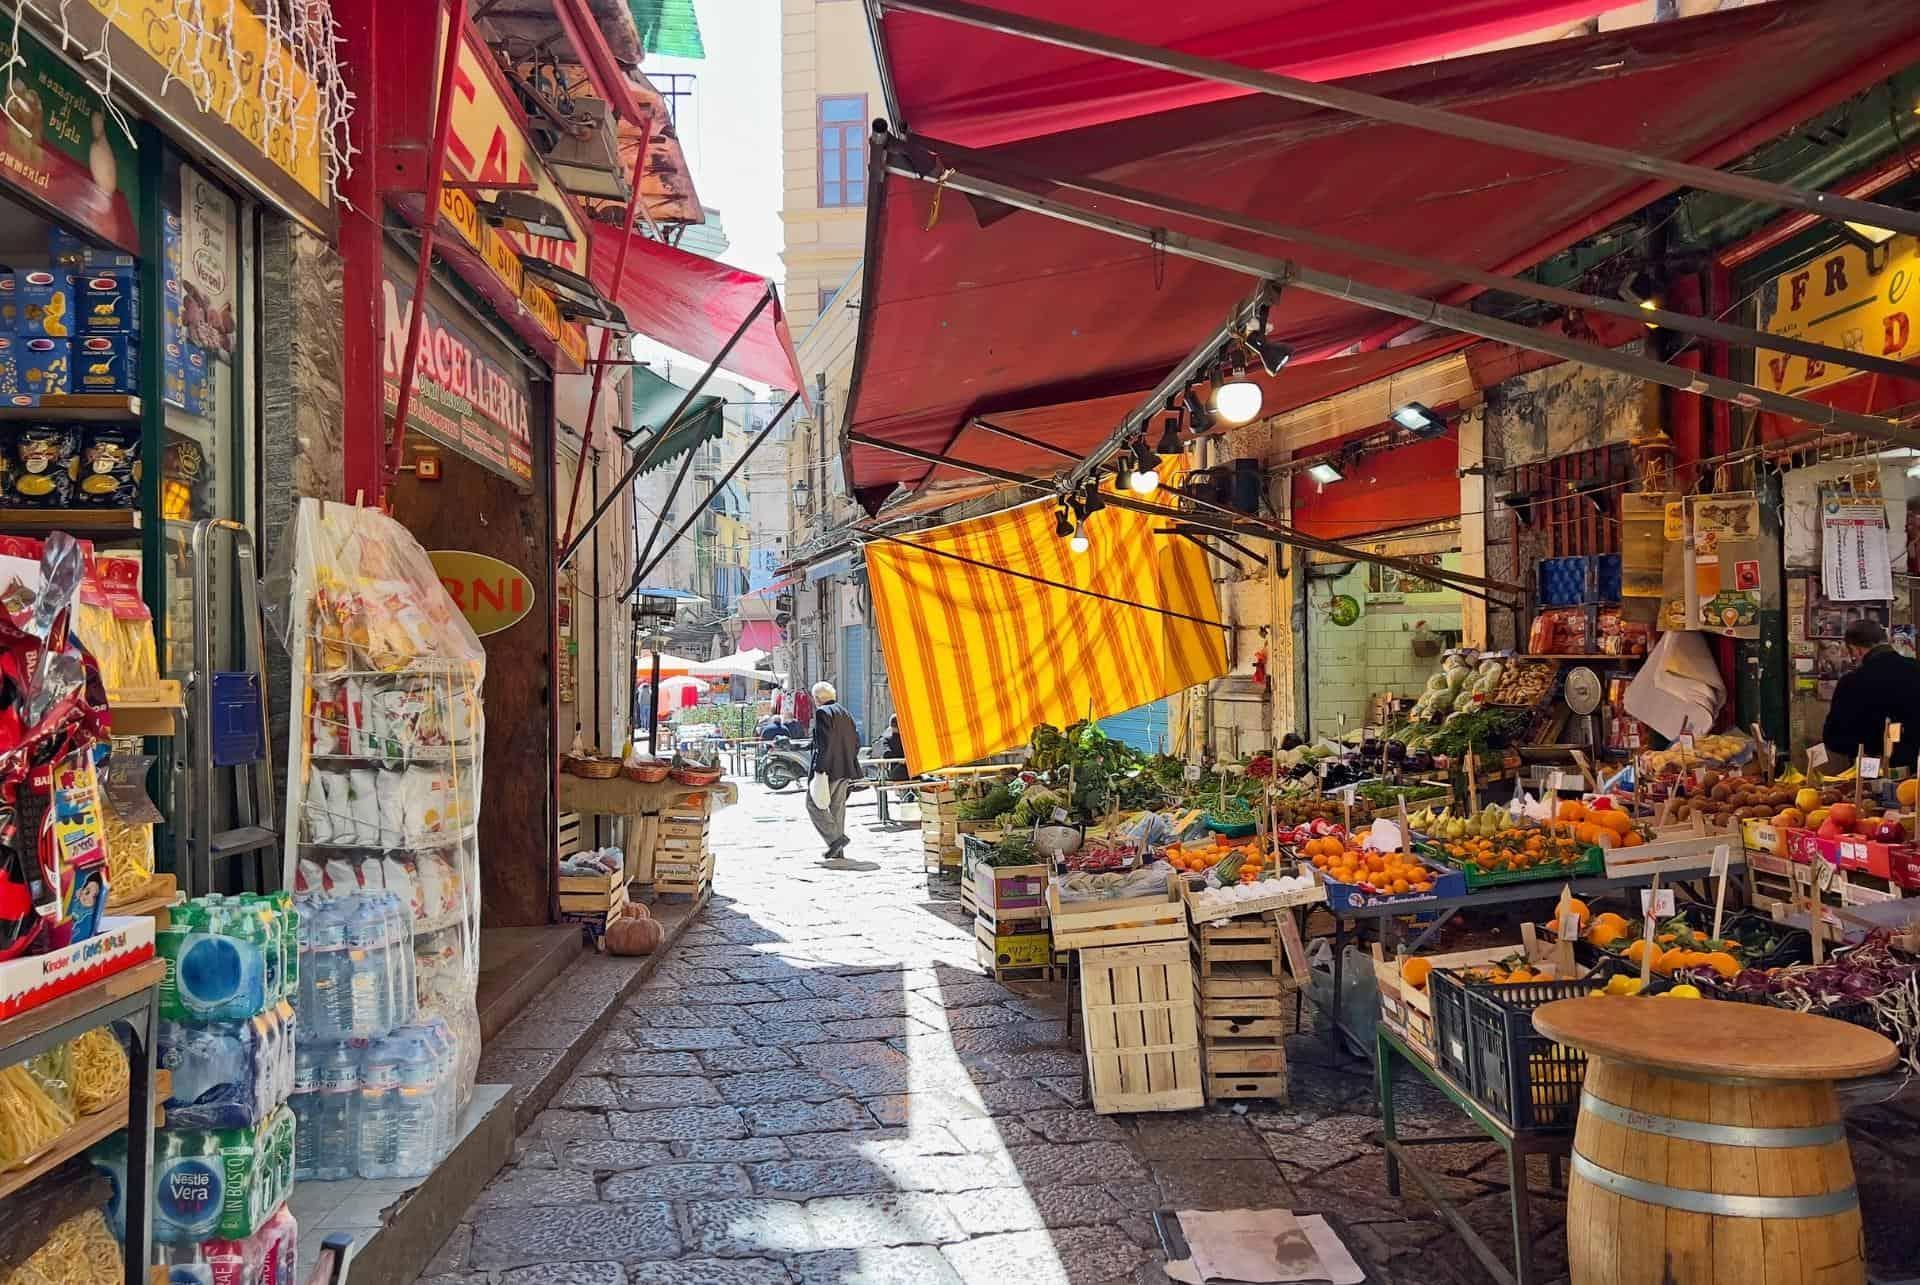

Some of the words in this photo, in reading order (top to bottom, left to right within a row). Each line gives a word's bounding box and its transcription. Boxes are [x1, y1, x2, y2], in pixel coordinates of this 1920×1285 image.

[48, 110, 81, 144] bufala
[383, 279, 531, 444] MACELLERIA
[440, 575, 525, 613] RNI
[42, 956, 70, 975] Kinder
[170, 1184, 209, 1201] Vera
[226, 1157, 246, 1197] BOSCO
